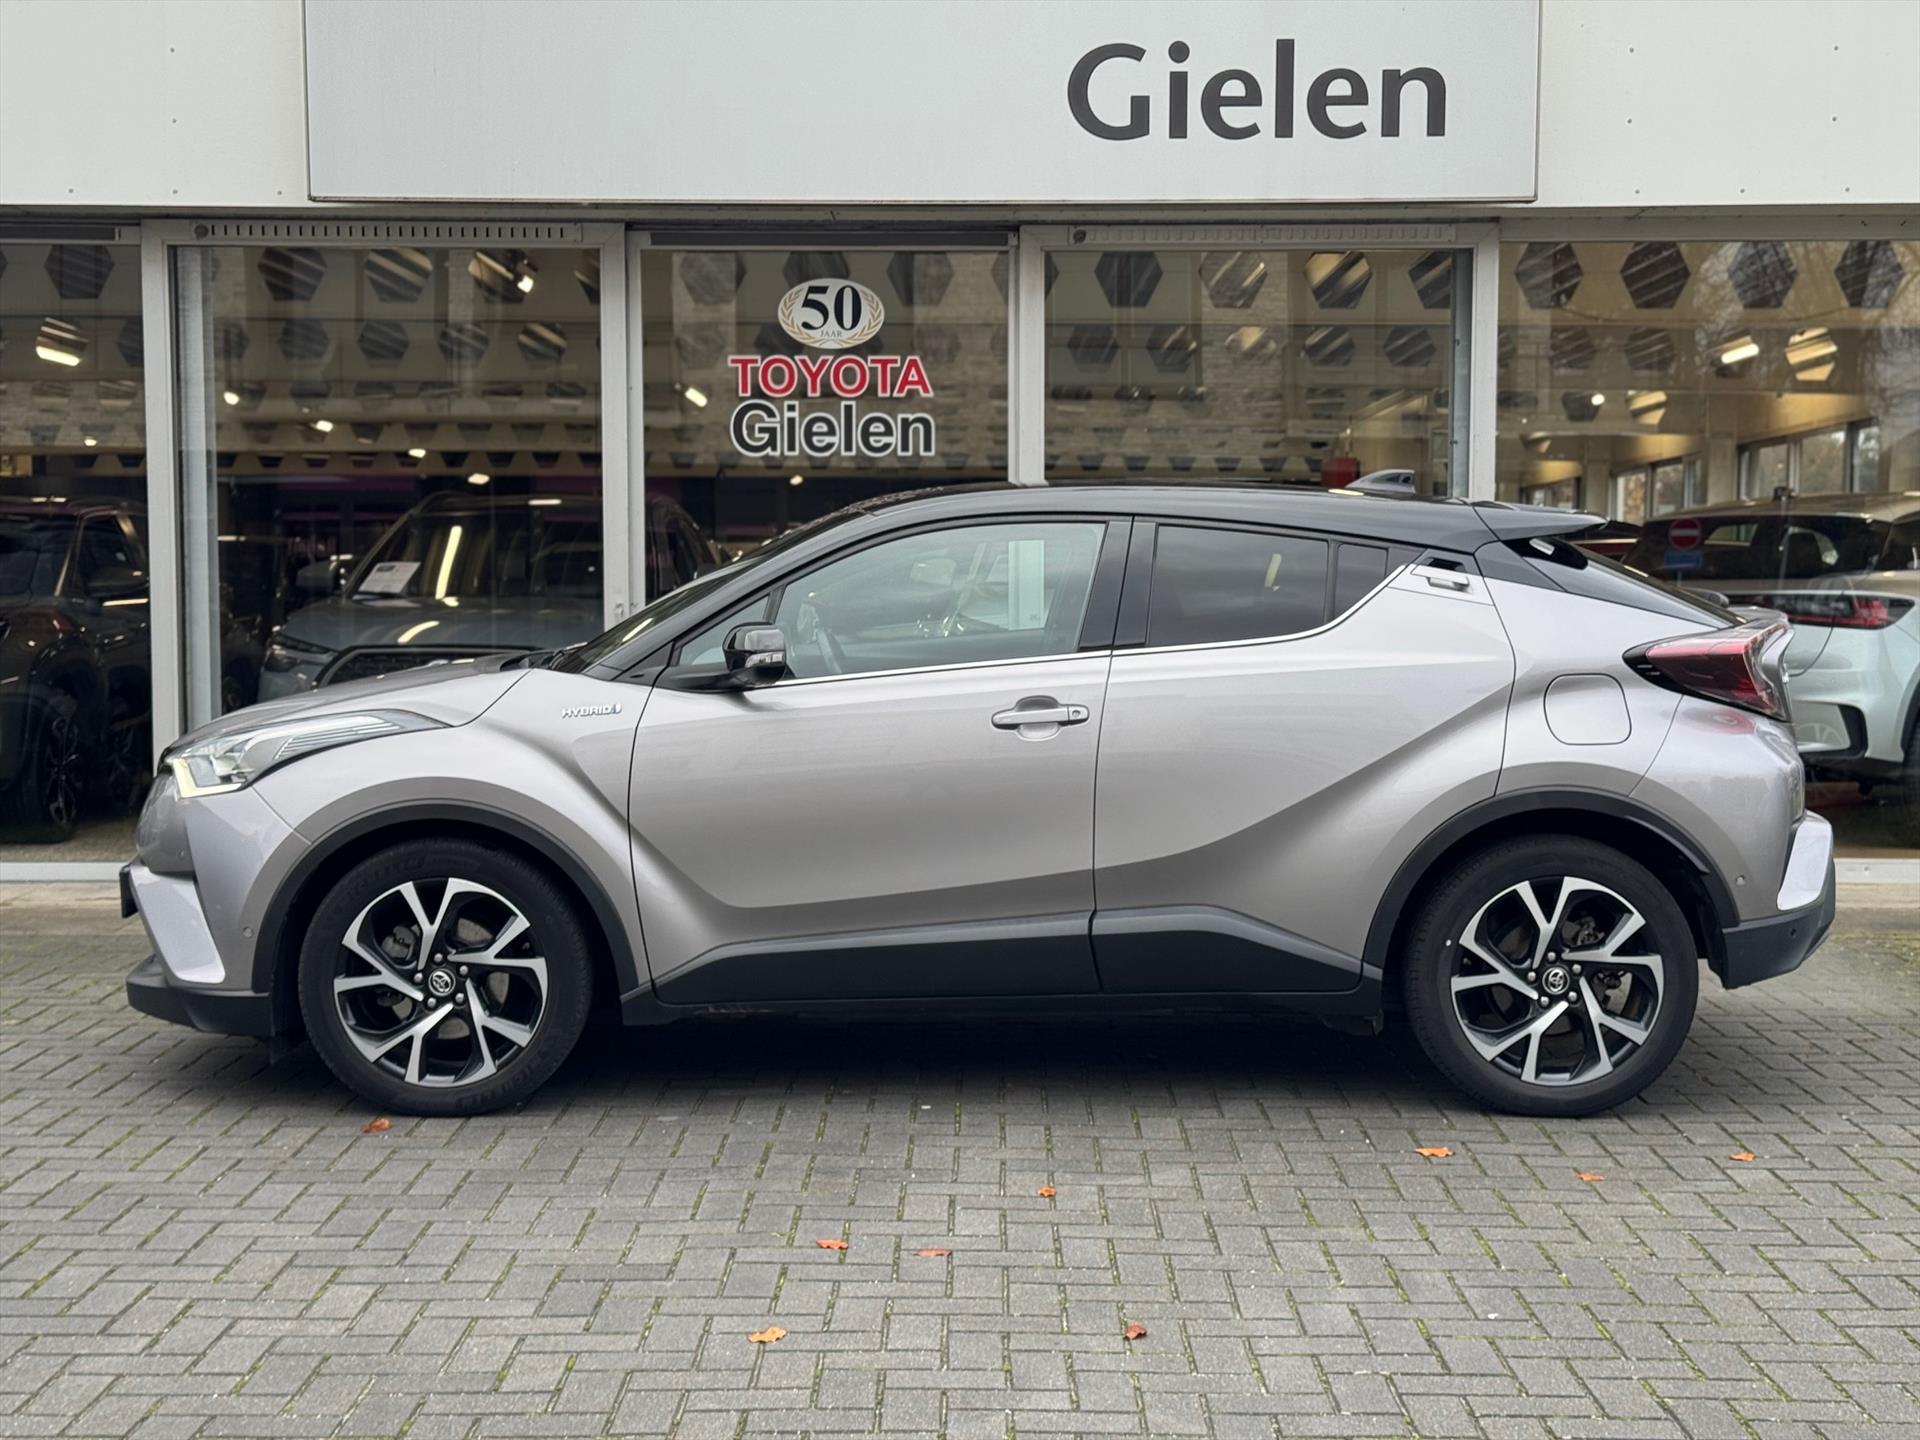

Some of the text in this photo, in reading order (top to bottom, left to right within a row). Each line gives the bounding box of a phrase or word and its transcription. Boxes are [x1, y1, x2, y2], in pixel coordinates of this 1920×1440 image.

[1067, 38, 1447, 141] Gielen
[800, 284, 863, 331] 50
[819, 329, 843, 338] JAAR
[728, 355, 935, 397] TOYOTA
[730, 399, 936, 457] Gielen
[562, 704, 612, 719] HYBRID
